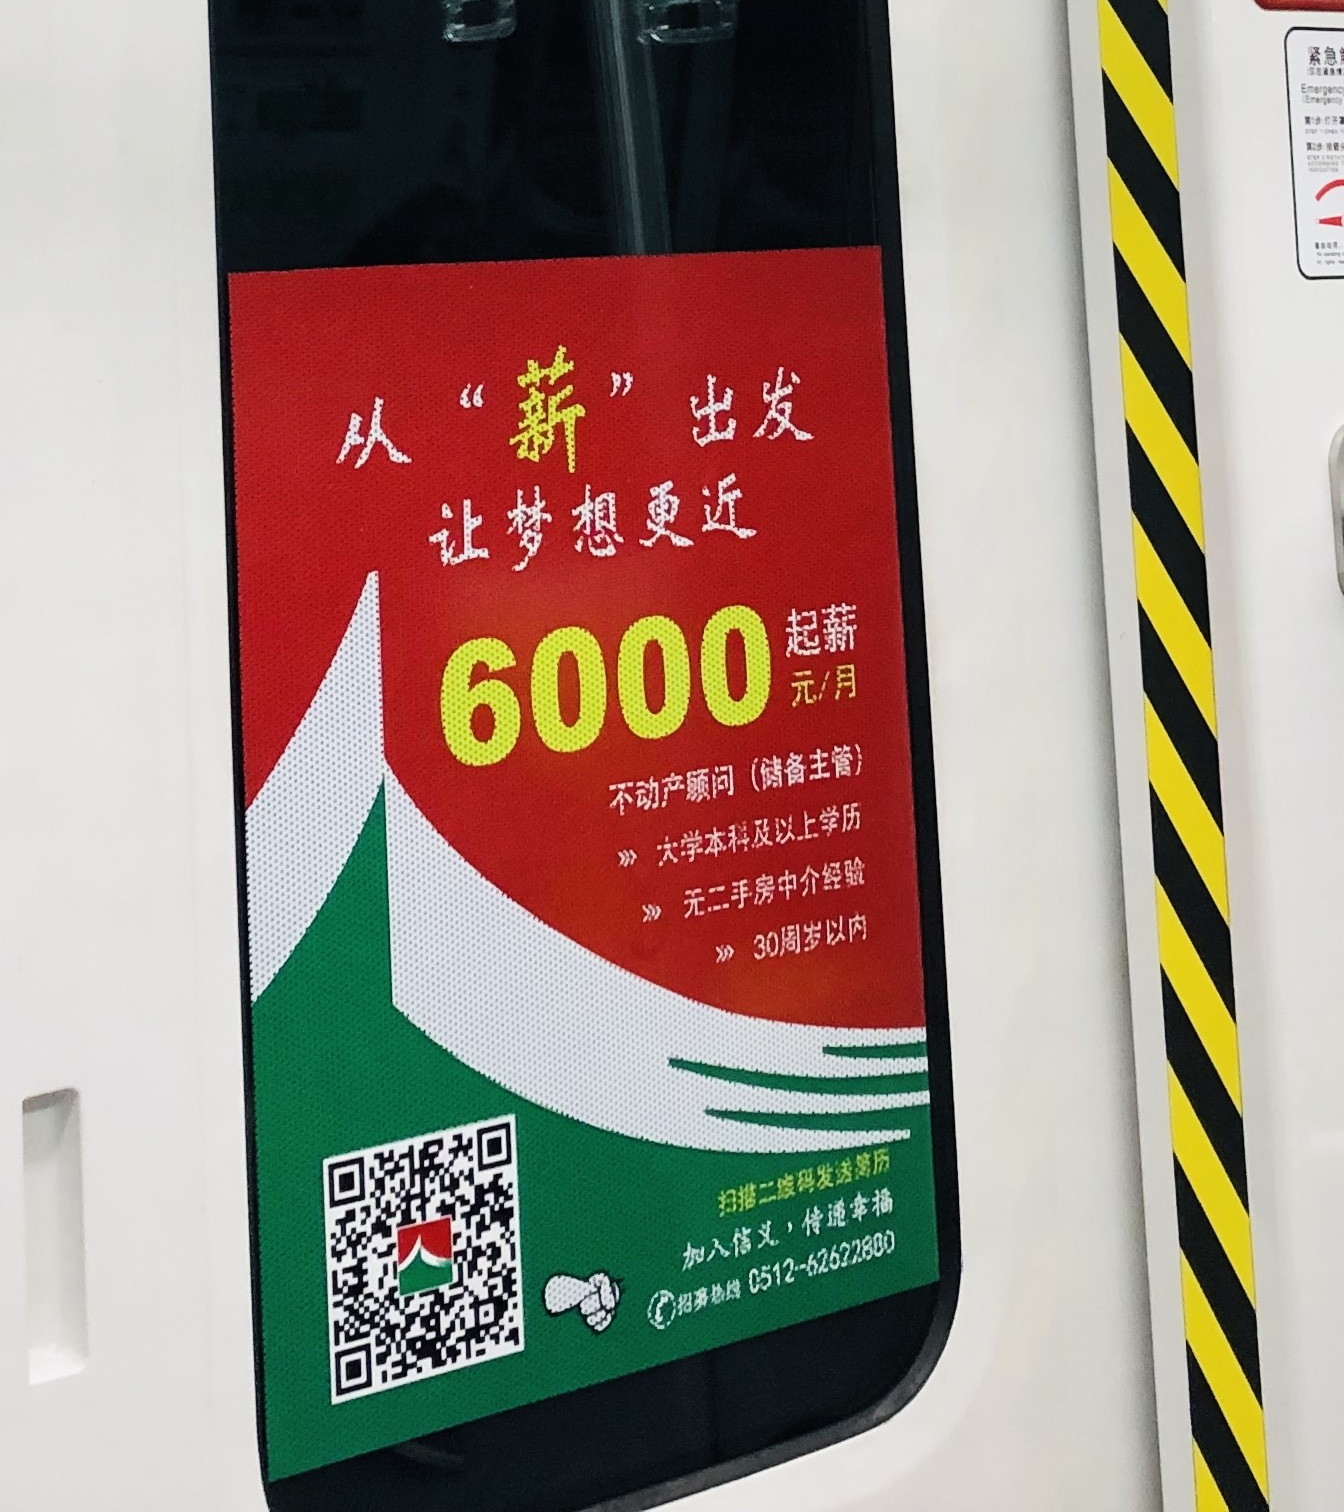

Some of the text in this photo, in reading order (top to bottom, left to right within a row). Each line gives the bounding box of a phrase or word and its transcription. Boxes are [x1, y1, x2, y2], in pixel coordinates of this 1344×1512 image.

[428, 473, 757, 572] 让梦想更近
[784, 602, 857, 657] 起薪
[439, 604, 772, 767] 6000
[790, 663, 857, 707] 元/月
[656, 801, 861, 867] 大学本科及以上学历
[683, 856, 866, 920] 无二手房中介经验
[753, 912, 868, 961] 30周岁以内
